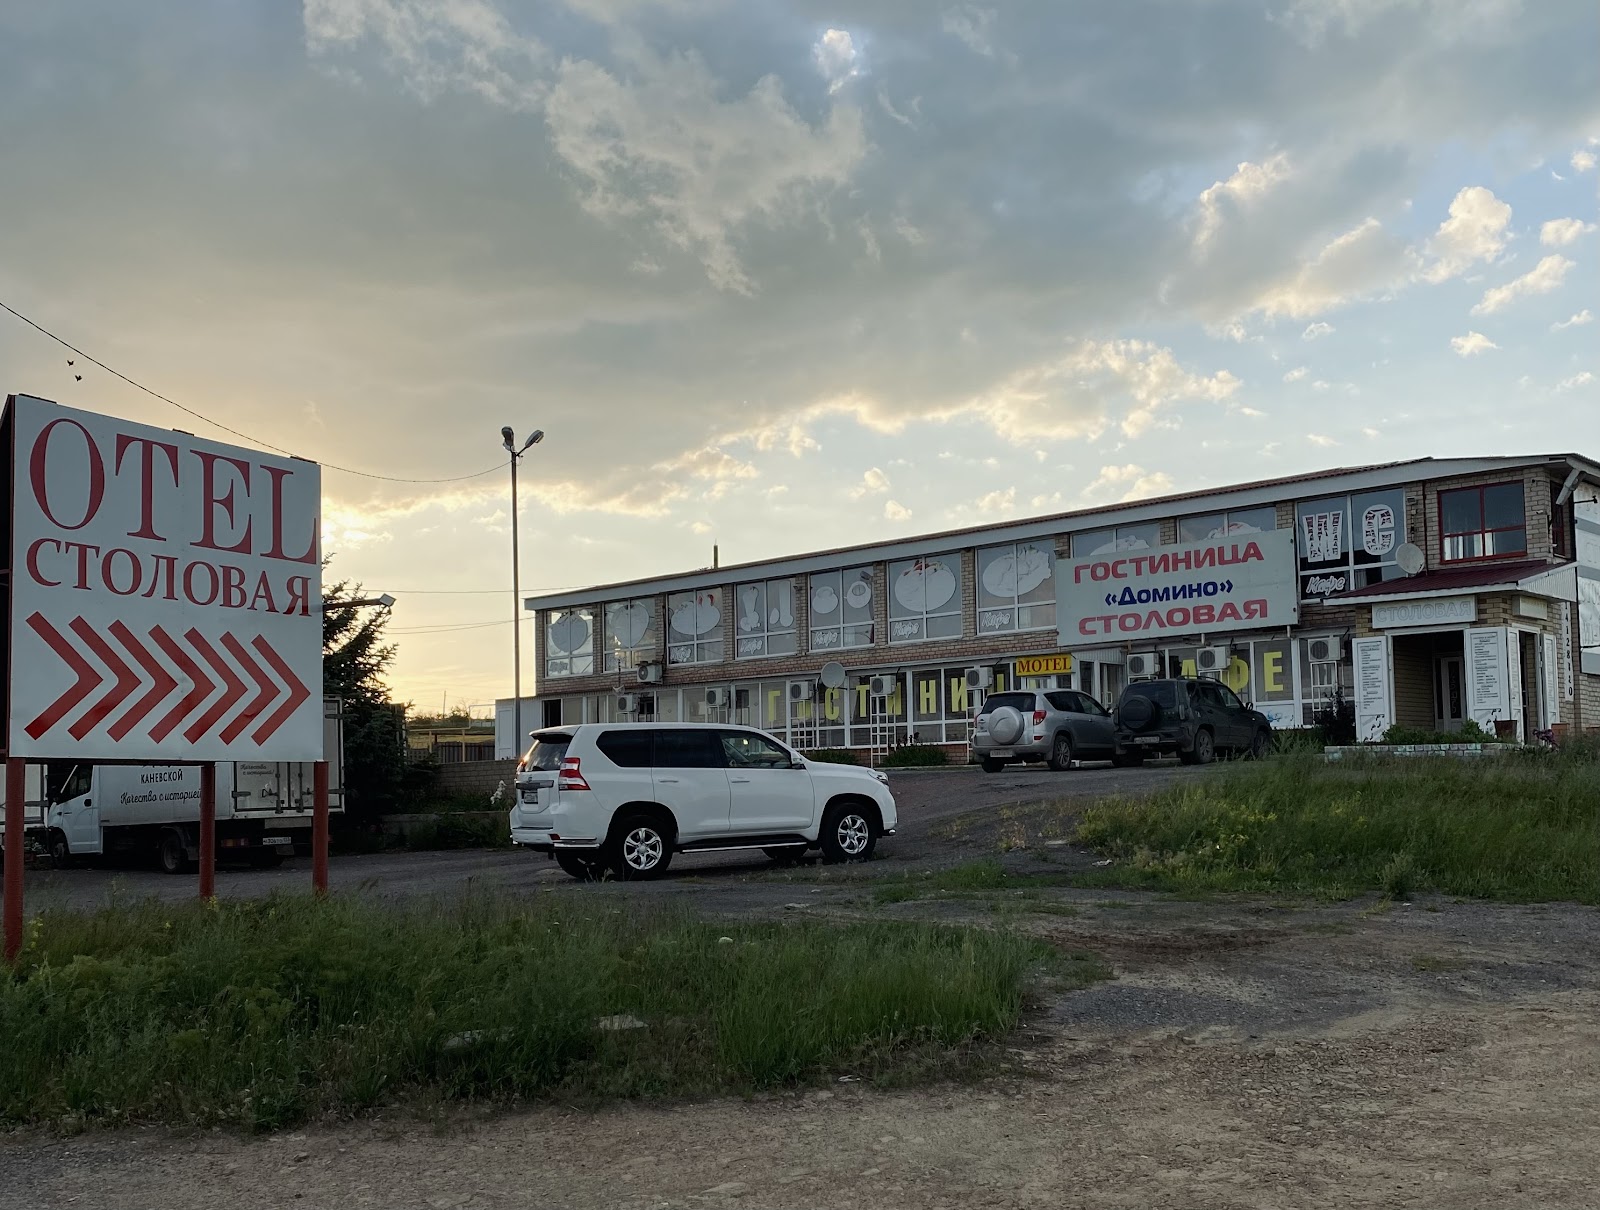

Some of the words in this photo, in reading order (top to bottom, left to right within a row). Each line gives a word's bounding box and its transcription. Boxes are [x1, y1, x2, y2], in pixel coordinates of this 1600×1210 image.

[29, 418, 317, 565] OTEL
[1074, 541, 1265, 584] ГОСТИНИЦА
[26, 537, 312, 617] СТОЛОВАЯ
[1306, 576, 1345, 596] Кафе
[1105, 579, 1234, 606] «Домино»
[981, 611, 1011, 629] Кафе
[1078, 598, 1268, 636] СТОЛОВАЯ
[1375, 601, 1471, 622] СТОЛОВАЯ
[893, 621, 920, 639] Кафе
[1018, 657, 1071, 673] MOTEL
[140, 769, 183, 784] КАНЕВСКОЙ
[120, 790, 157, 805] Качество
